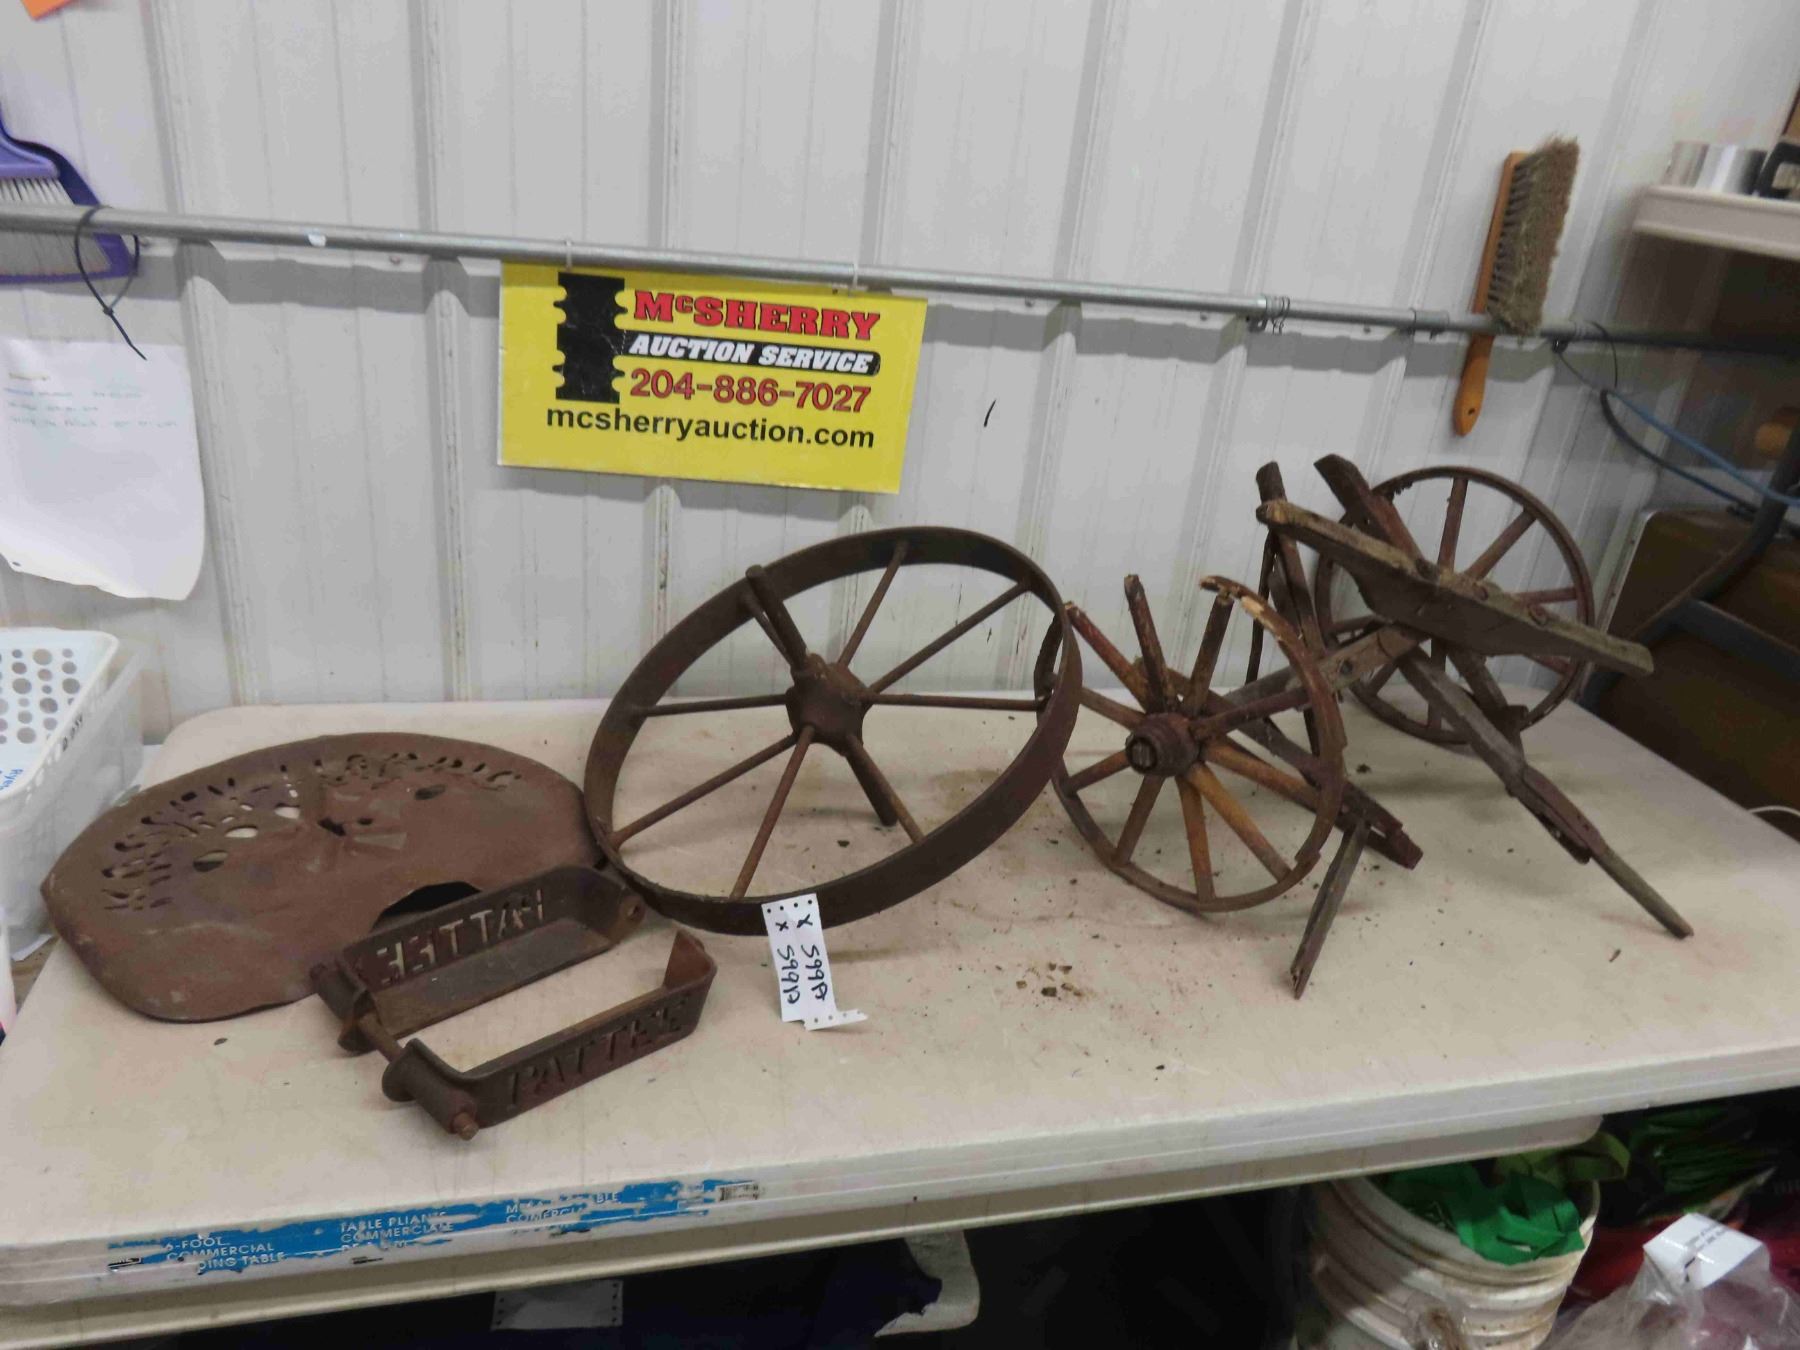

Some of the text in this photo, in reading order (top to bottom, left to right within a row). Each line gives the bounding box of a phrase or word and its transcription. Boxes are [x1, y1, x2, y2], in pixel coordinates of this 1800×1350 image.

[629, 338, 874, 373] AUCTION SERVICE
[630, 368, 871, 414] 204-886-7027
[546, 407, 875, 448] mcsherryauction.com
[340, 1219, 383, 1233] TABLE
[241, 1250, 286, 1266] TABLE
